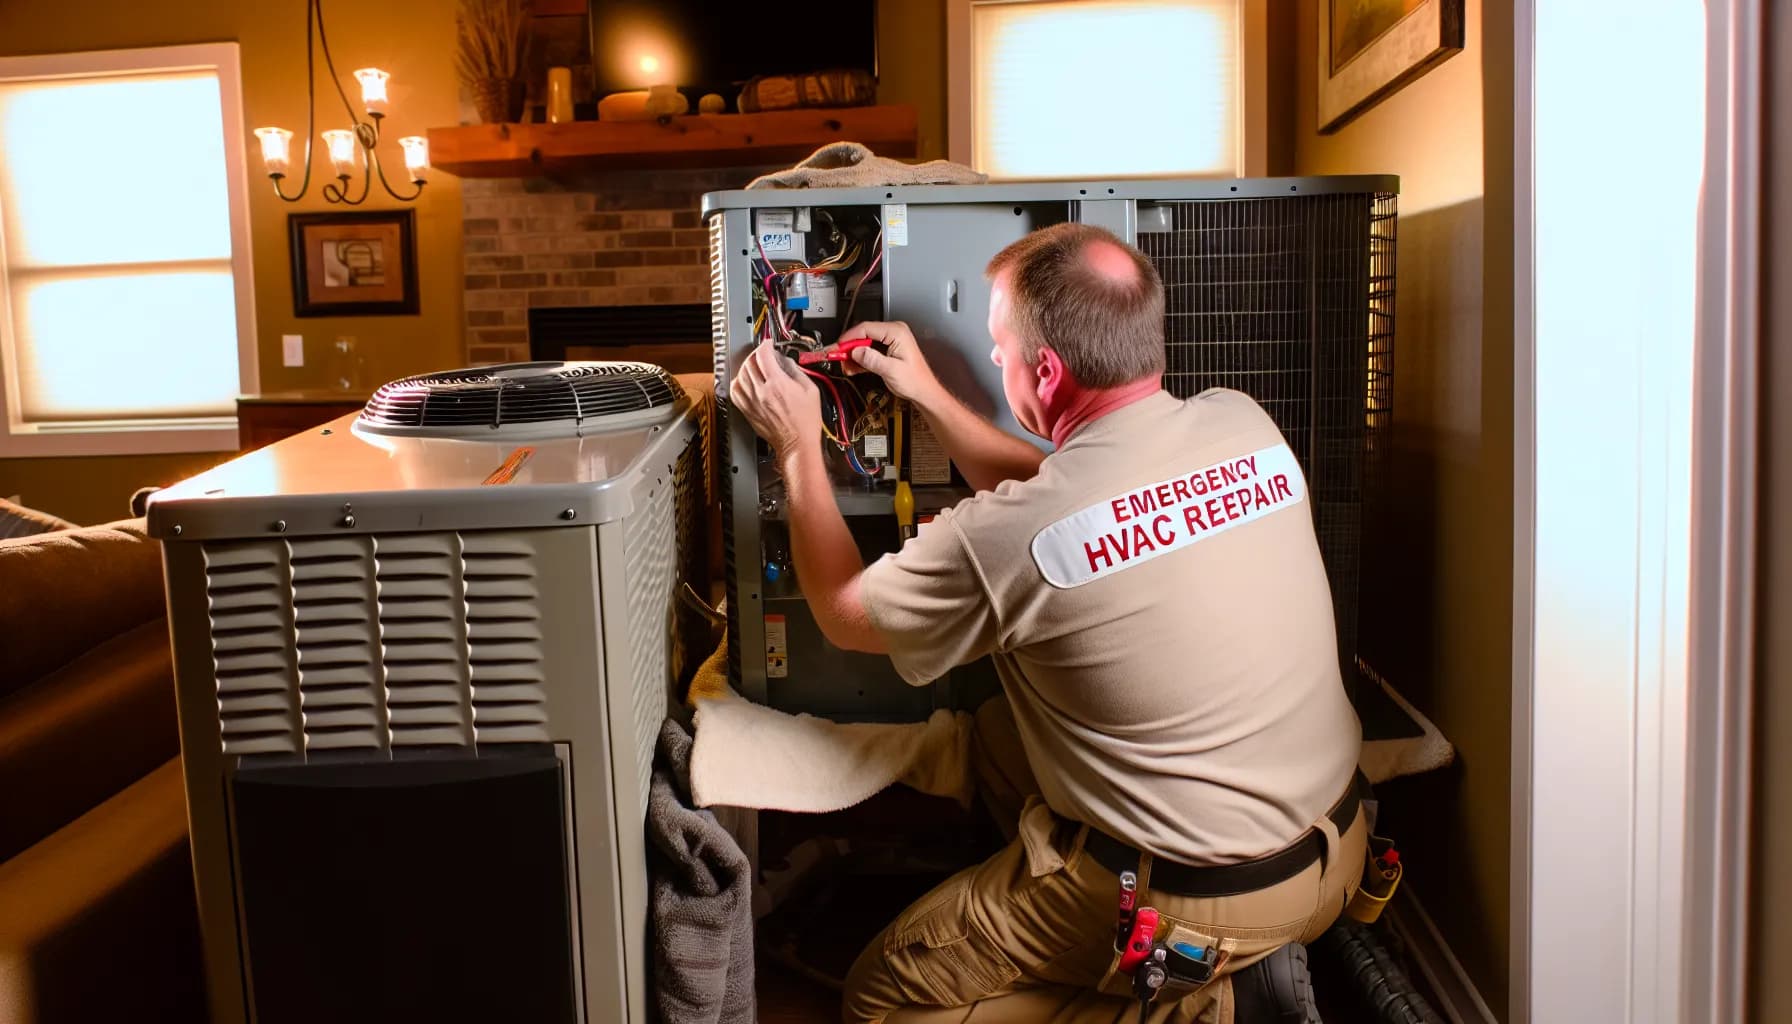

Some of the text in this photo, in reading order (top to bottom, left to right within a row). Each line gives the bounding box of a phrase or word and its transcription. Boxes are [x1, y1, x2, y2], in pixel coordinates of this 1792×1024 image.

[1084, 474, 1293, 573] HVAC REEPAIR
[1111, 456, 1258, 523] EMERGENCY
